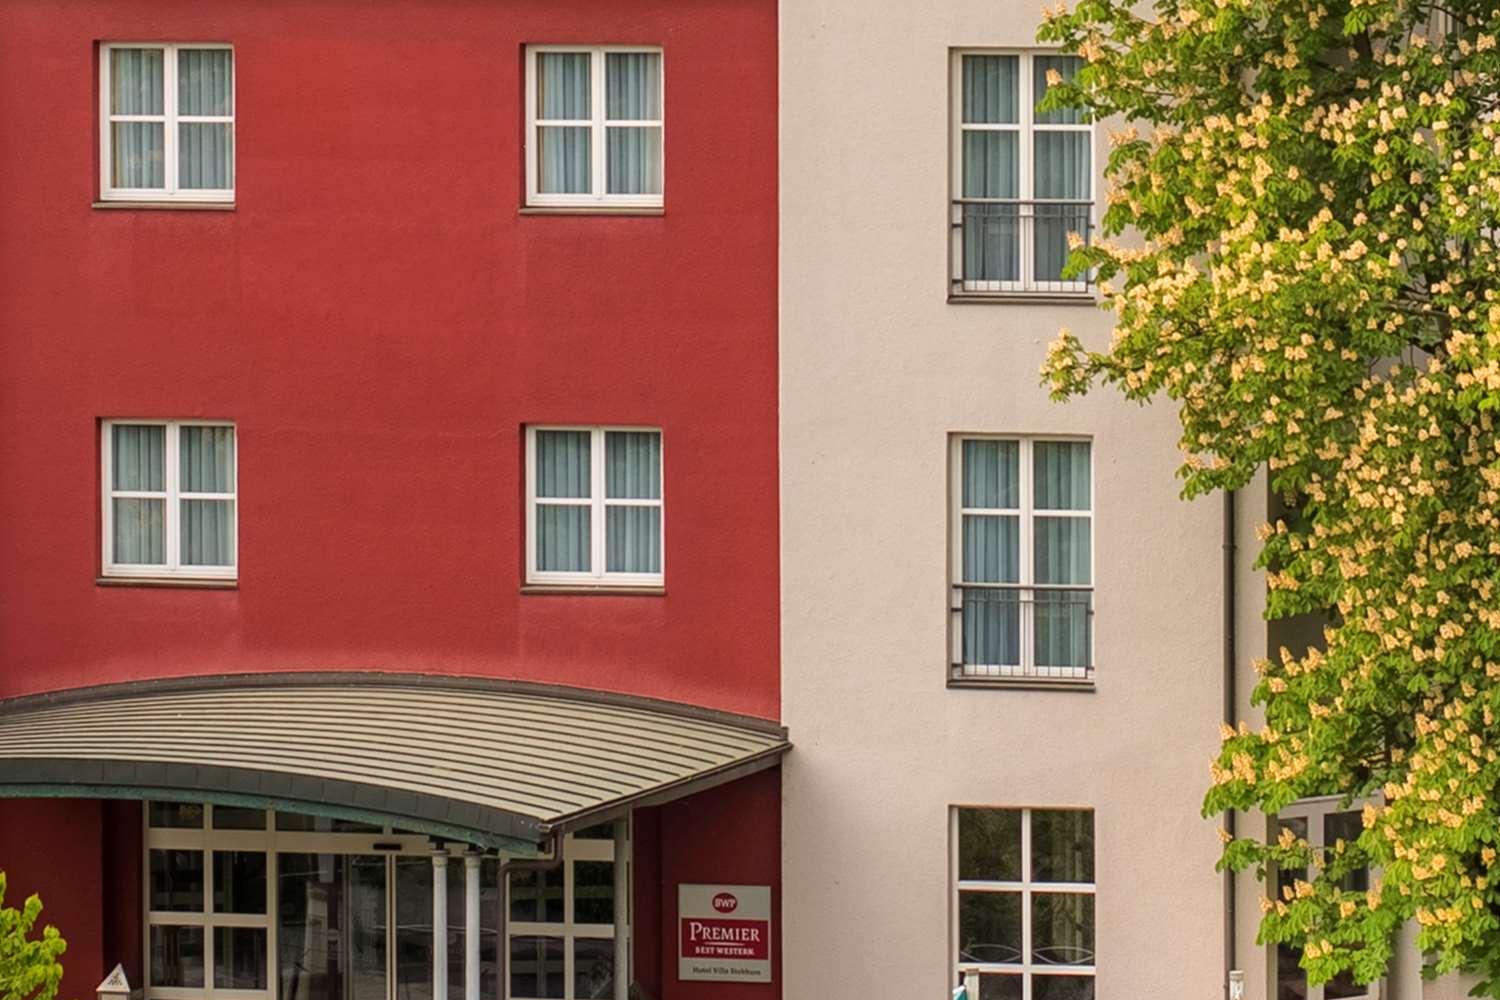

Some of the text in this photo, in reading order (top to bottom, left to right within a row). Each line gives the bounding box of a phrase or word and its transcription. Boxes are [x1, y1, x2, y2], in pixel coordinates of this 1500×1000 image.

[689, 921, 760, 942] PREMIER
[695, 946, 755, 955] BEST WESTERN
